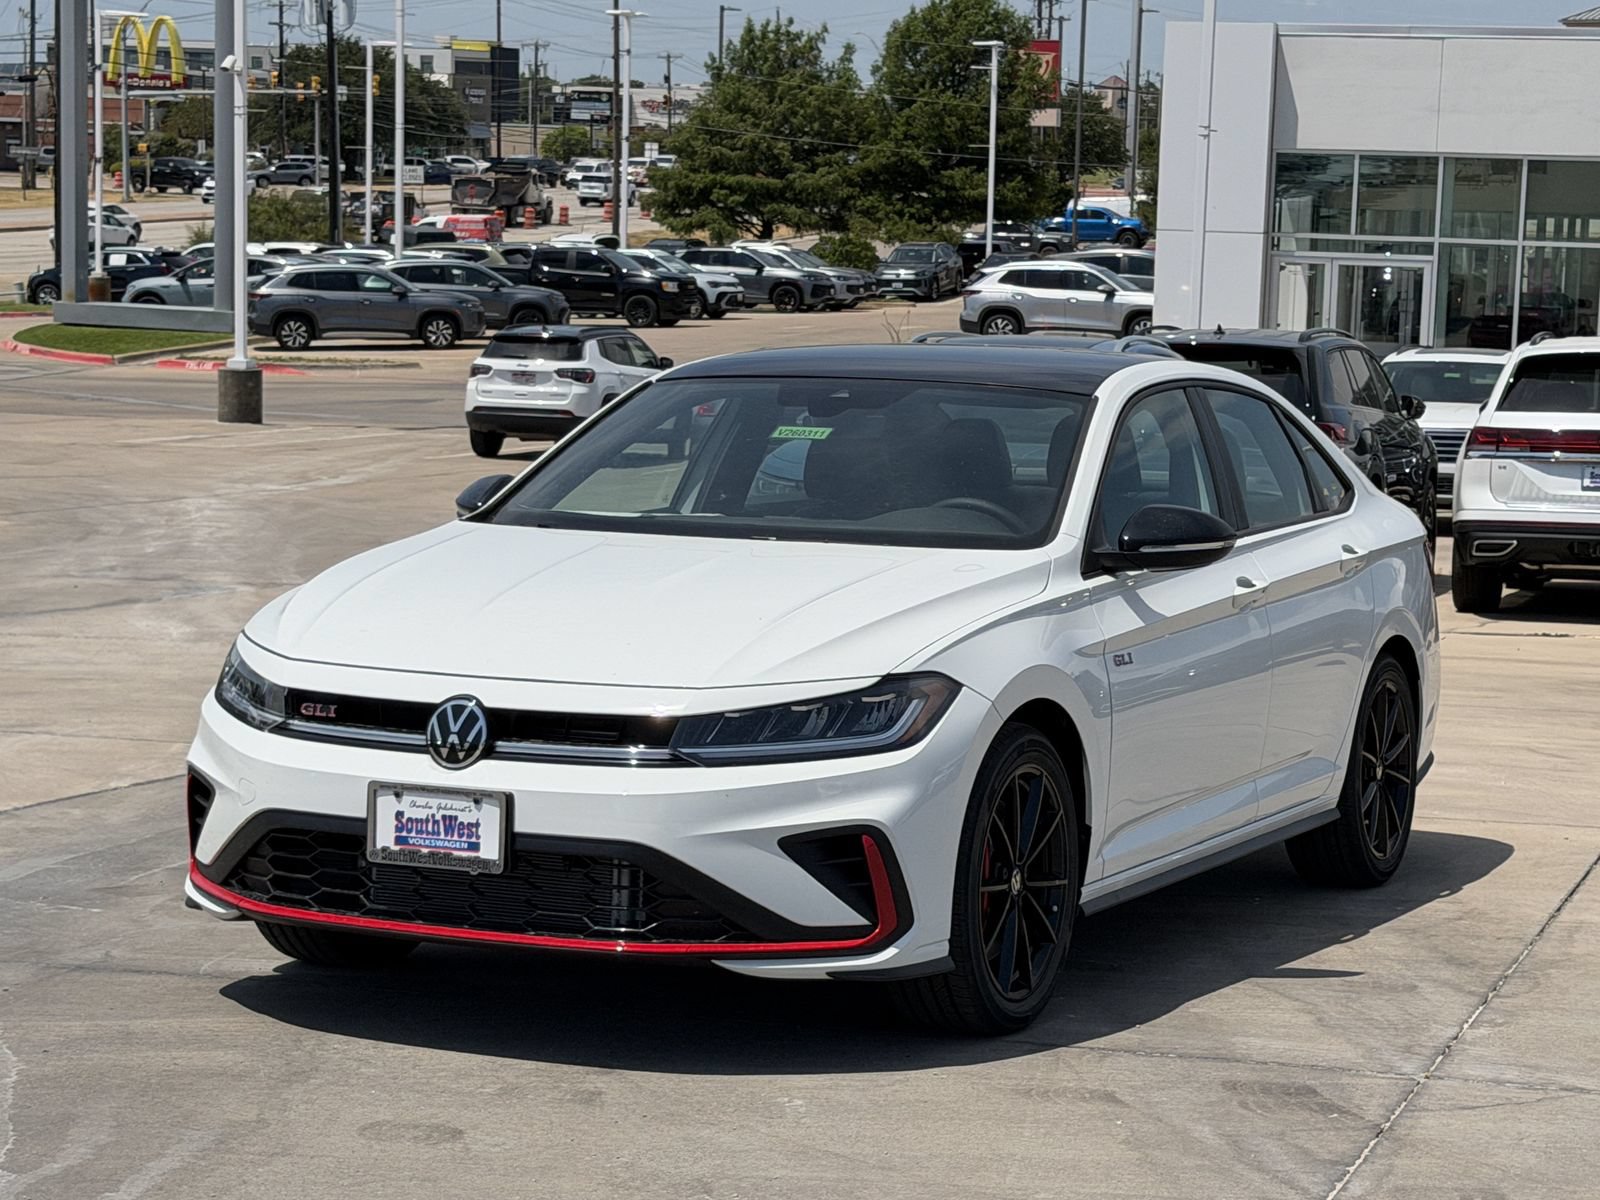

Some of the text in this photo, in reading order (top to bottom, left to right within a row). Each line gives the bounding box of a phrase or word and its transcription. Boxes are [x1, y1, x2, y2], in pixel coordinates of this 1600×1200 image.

[778, 428, 827, 438] V260311
[1112, 651, 1134, 667] GLI
[300, 702, 338, 718] GLI
[407, 837, 469, 849] VOLKSWAGEN
